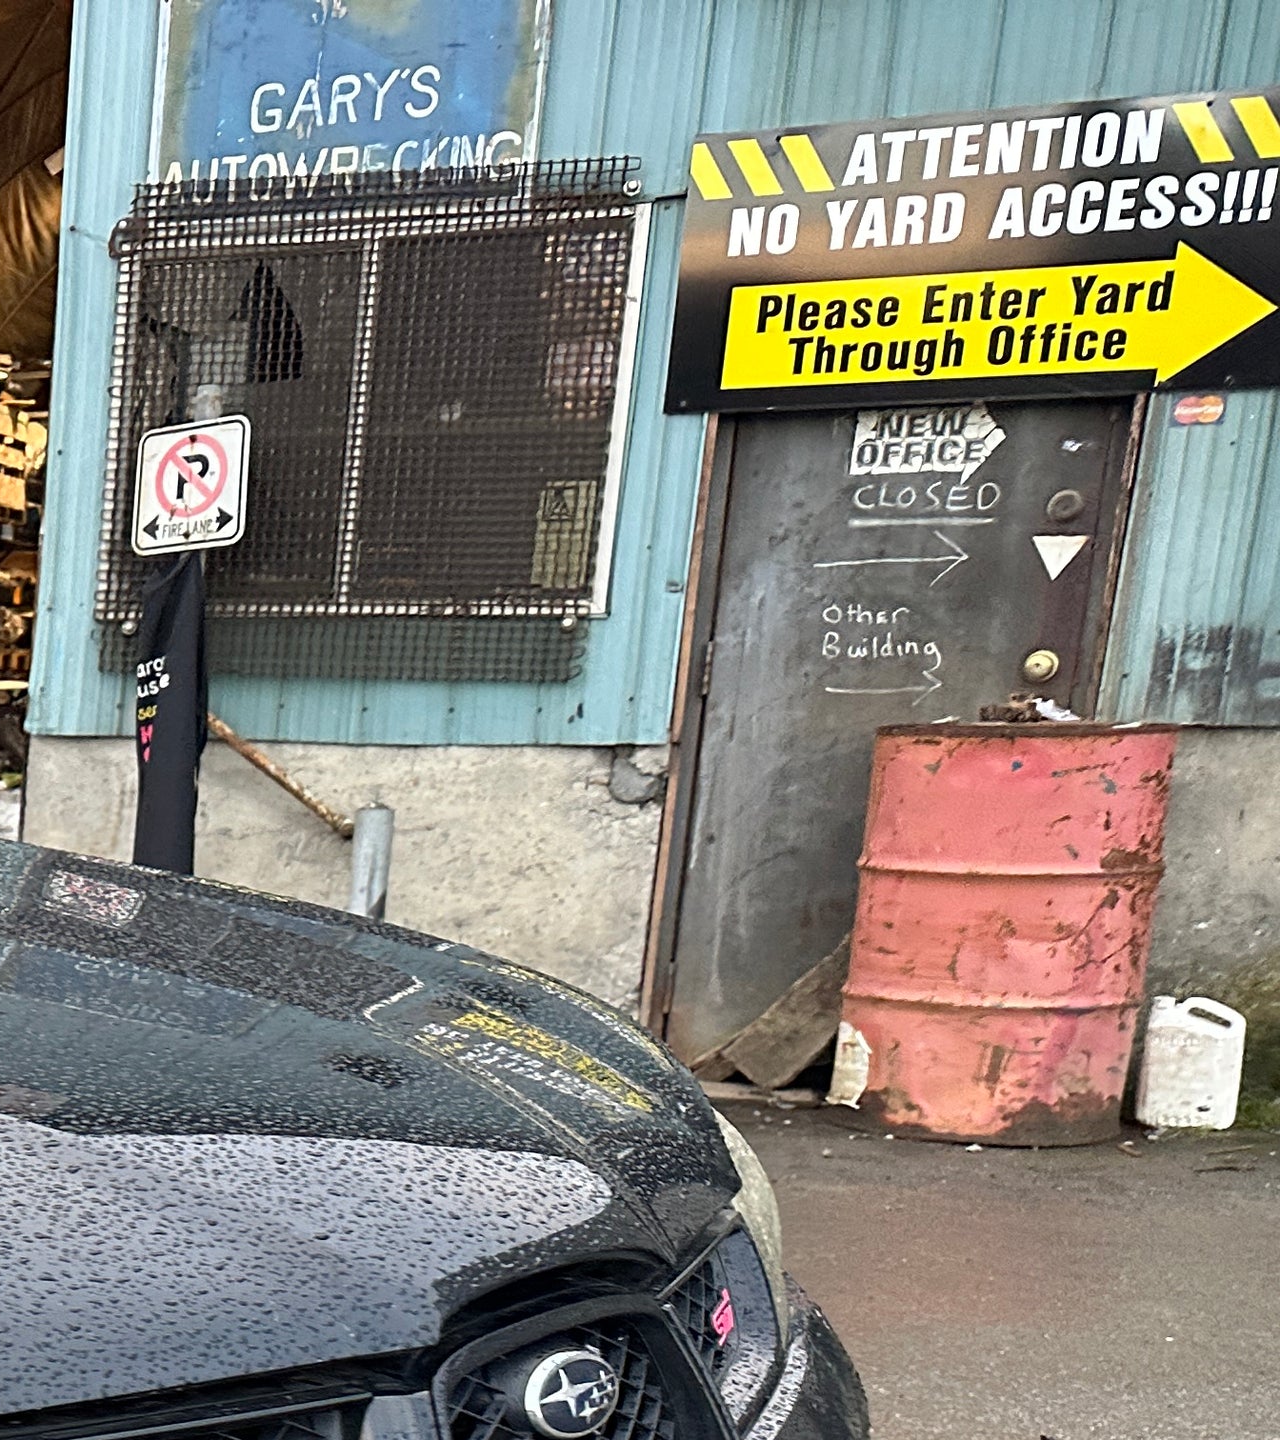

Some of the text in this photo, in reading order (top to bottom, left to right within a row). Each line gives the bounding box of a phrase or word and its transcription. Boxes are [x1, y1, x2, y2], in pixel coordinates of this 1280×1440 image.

[250, 64, 441, 134] GARY'S
[841, 108, 1166, 187] ATTENTION
[727, 167, 1279, 257] NO YARD ACCESS!!!
[756, 271, 1175, 333] Please Enter Yard
[788, 322, 1127, 376] Through Office
[878, 412, 969, 438] NEW
[857, 438, 987, 467] OFFICE
[853, 482, 1002, 511] CLOSED
[162, 522, 182, 538] FIRE
[823, 604, 910, 624] Other
[822, 632, 942, 673] Building
